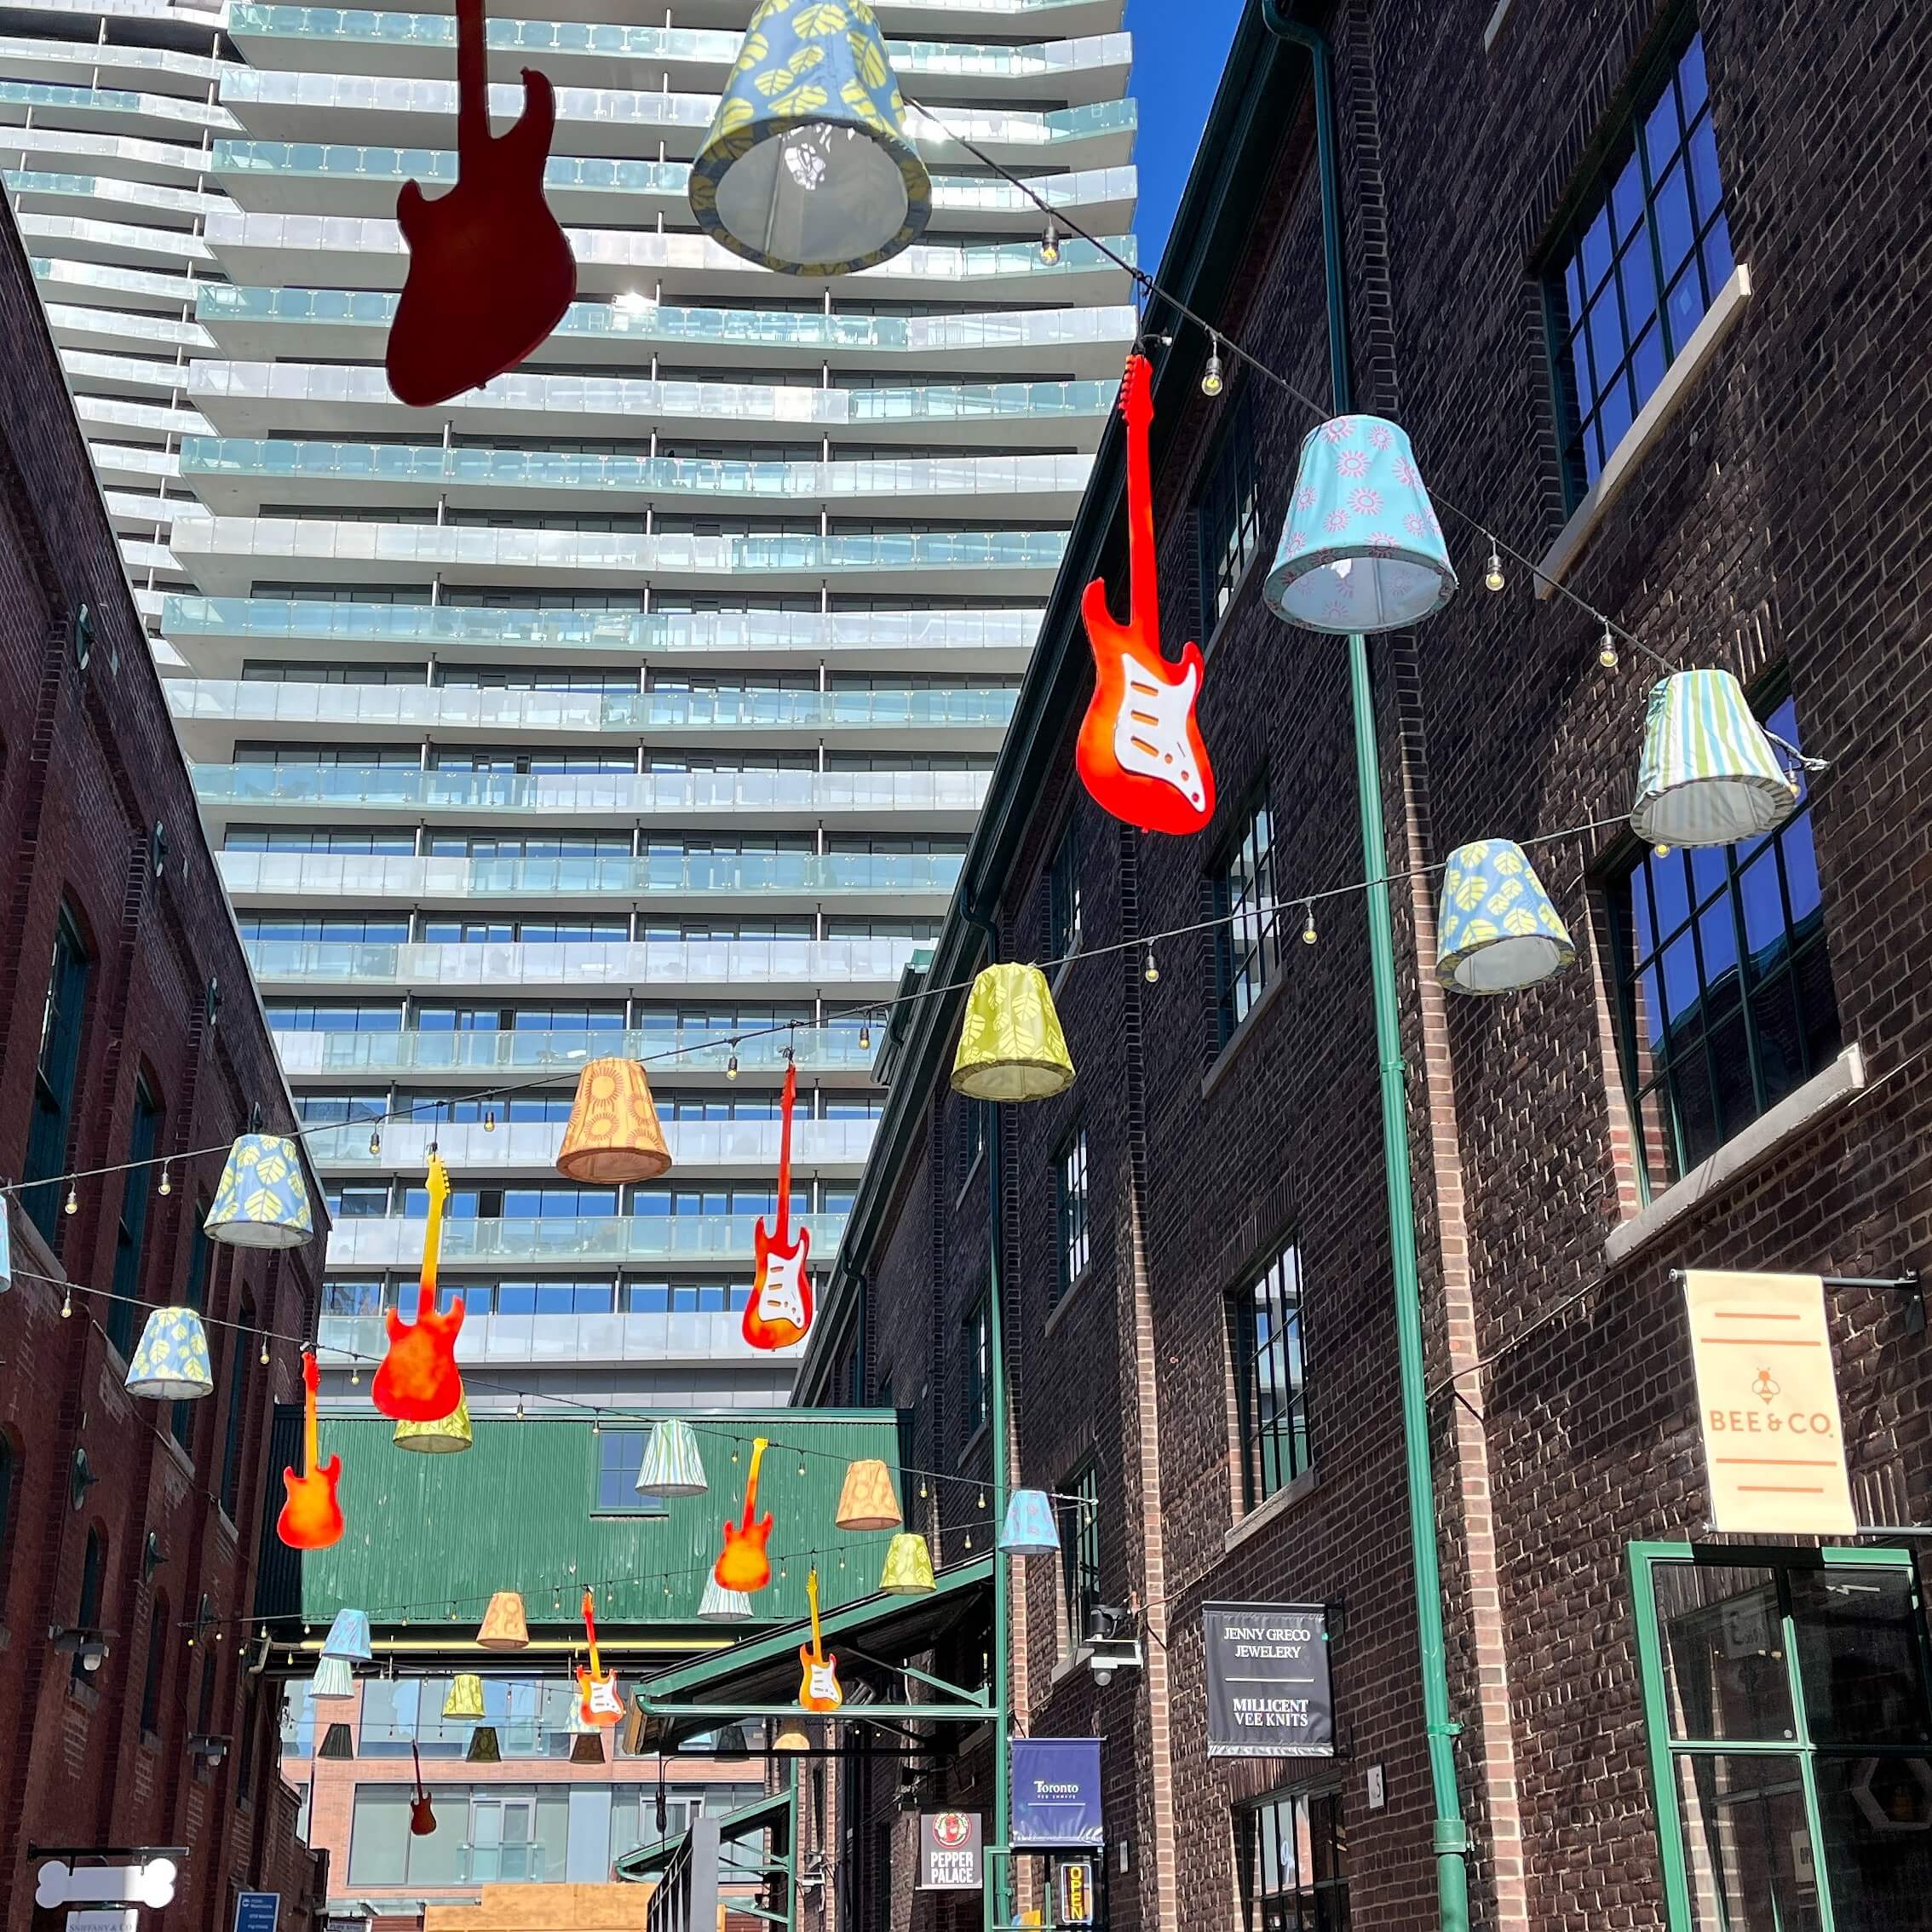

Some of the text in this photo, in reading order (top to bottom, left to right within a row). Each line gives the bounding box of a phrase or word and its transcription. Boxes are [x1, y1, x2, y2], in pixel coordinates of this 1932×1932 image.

[1710, 1411, 1762, 1432] BEE
[1768, 1413, 1783, 1432] &
[1223, 1627, 1311, 1642] JENNY GRECO
[1234, 1645, 1302, 1659] JEWELERY
[1233, 1699, 1309, 1712] MILLICENT
[1234, 1712, 1308, 1728] VEE KNITS
[1033, 1780, 1079, 1793] Toronto
[930, 1851, 974, 1868] PEPPER
[931, 1867, 974, 1883] PALACE
[1070, 1866, 1084, 1920] OPEN
